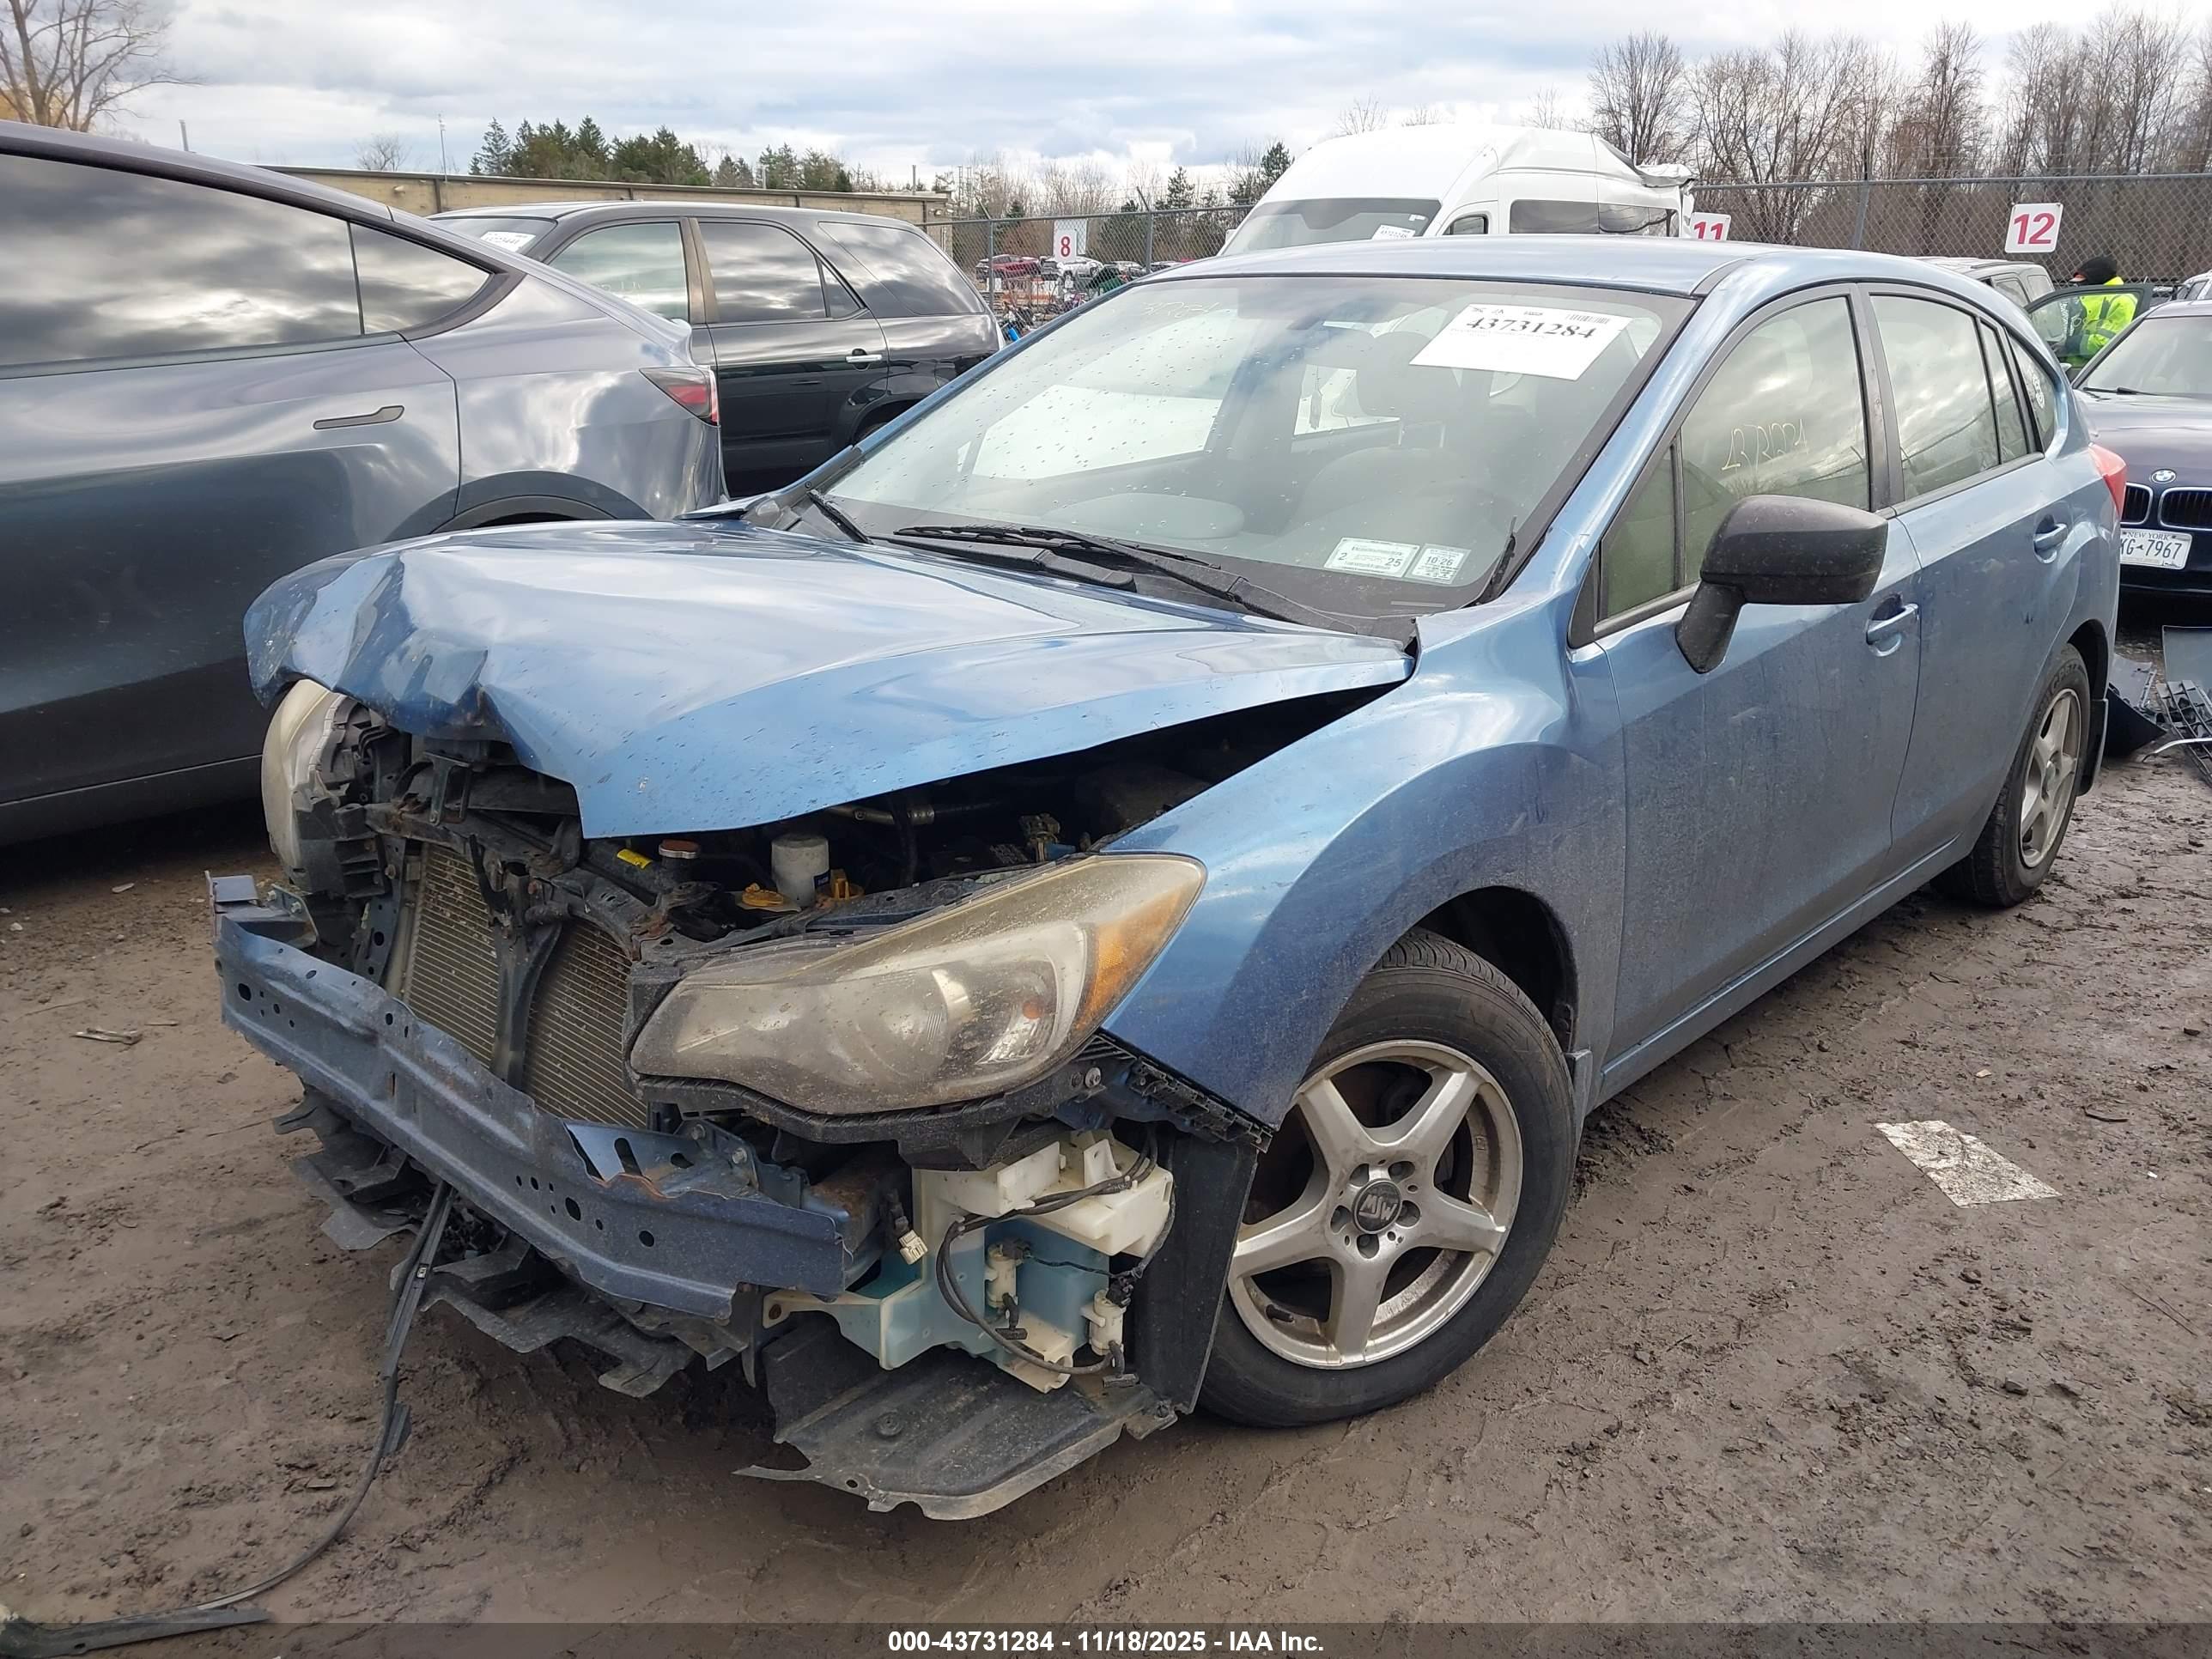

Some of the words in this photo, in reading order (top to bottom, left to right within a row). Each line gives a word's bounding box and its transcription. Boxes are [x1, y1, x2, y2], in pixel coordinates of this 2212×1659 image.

[1693, 221, 1724, 240] 11
[2014, 213, 2055, 244] 12
[1060, 236, 1071, 258] 8
[1466, 316, 1597, 339] 43731284
[2148, 532, 2170, 541] YORK
[1385, 557, 1403, 568] 25
